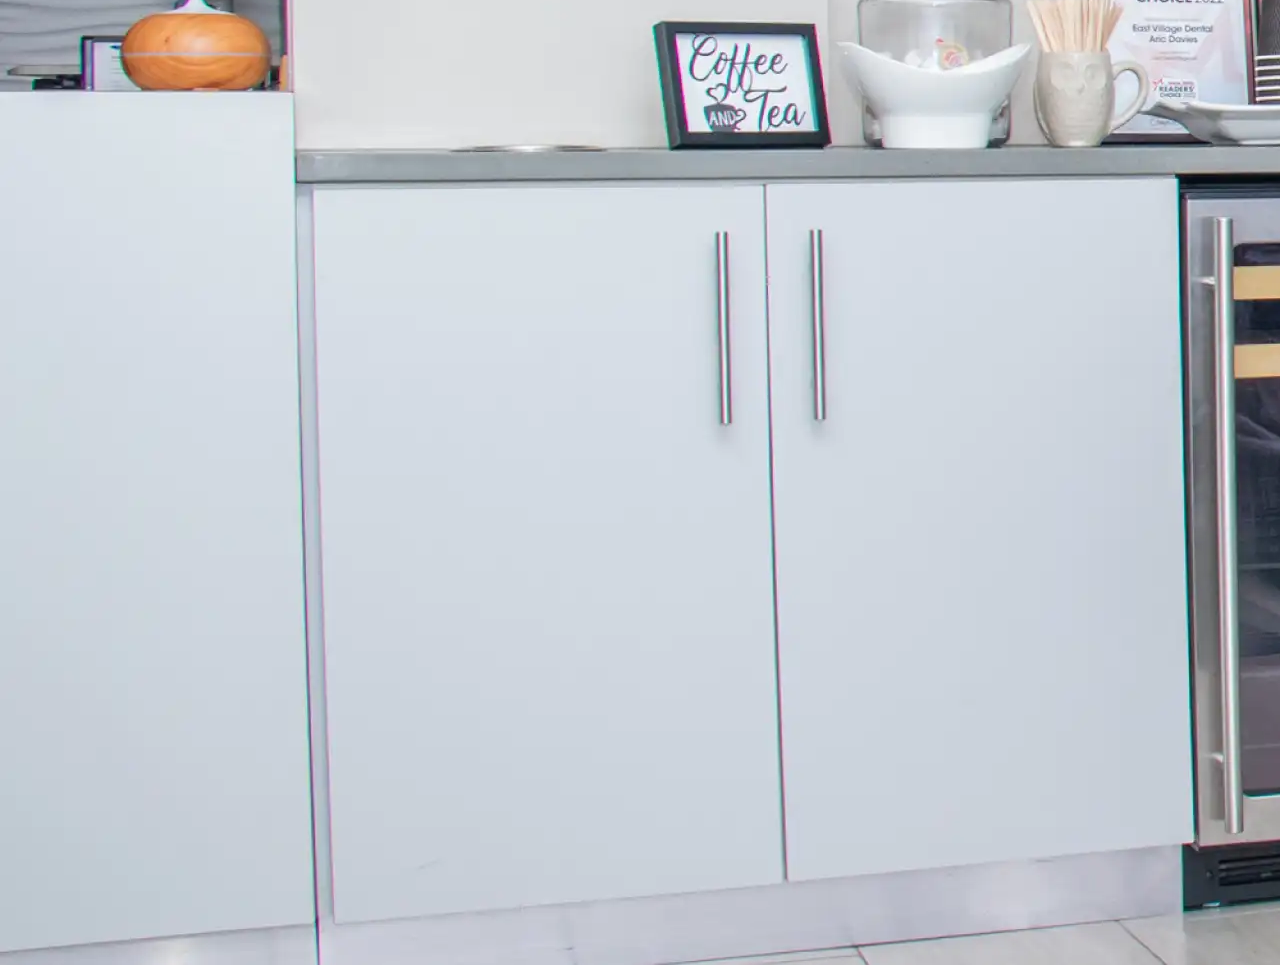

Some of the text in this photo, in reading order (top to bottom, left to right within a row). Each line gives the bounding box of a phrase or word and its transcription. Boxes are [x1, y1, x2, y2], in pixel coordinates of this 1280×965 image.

[1132, 23, 1213, 34] East Village Dental
[1169, 35, 1198, 43] Davies
[689, 34, 788, 102] Coffee
[709, 86, 806, 132] AND Tea
